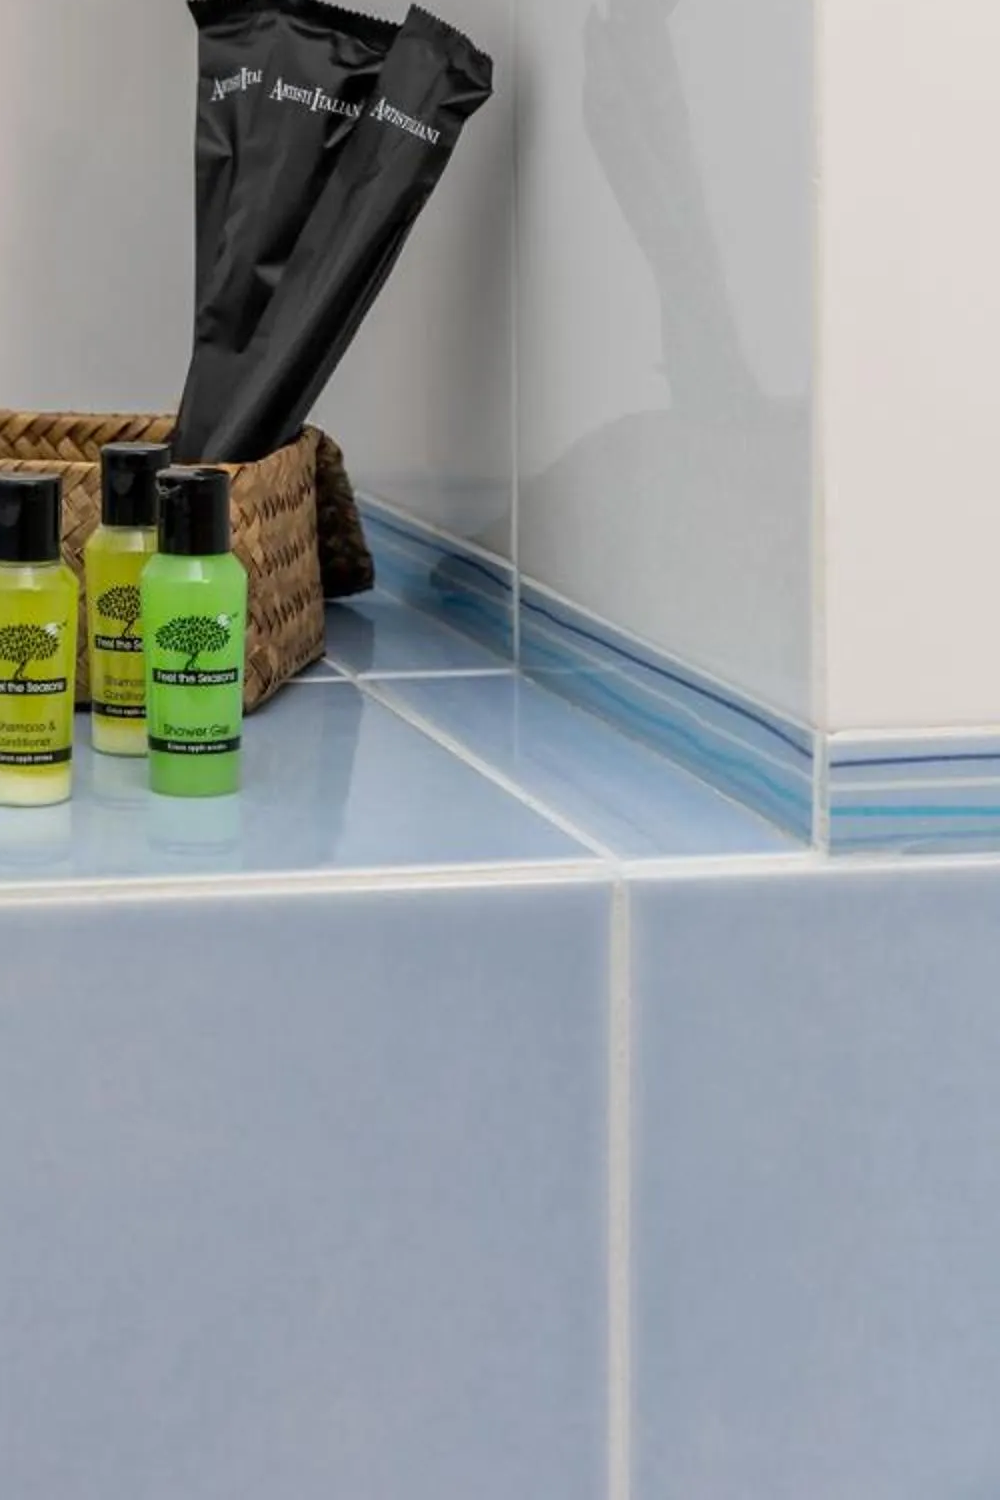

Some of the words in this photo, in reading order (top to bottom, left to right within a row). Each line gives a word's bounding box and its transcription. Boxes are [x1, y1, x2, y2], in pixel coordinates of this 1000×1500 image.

[116, 638, 132, 651] the
[157, 671, 177, 682] Feel
[178, 672, 197, 684] the
[7, 681, 25, 693] the
[48, 720, 57, 731] &
[163, 723, 208, 737] Shower
[210, 723, 230, 736] Gel
